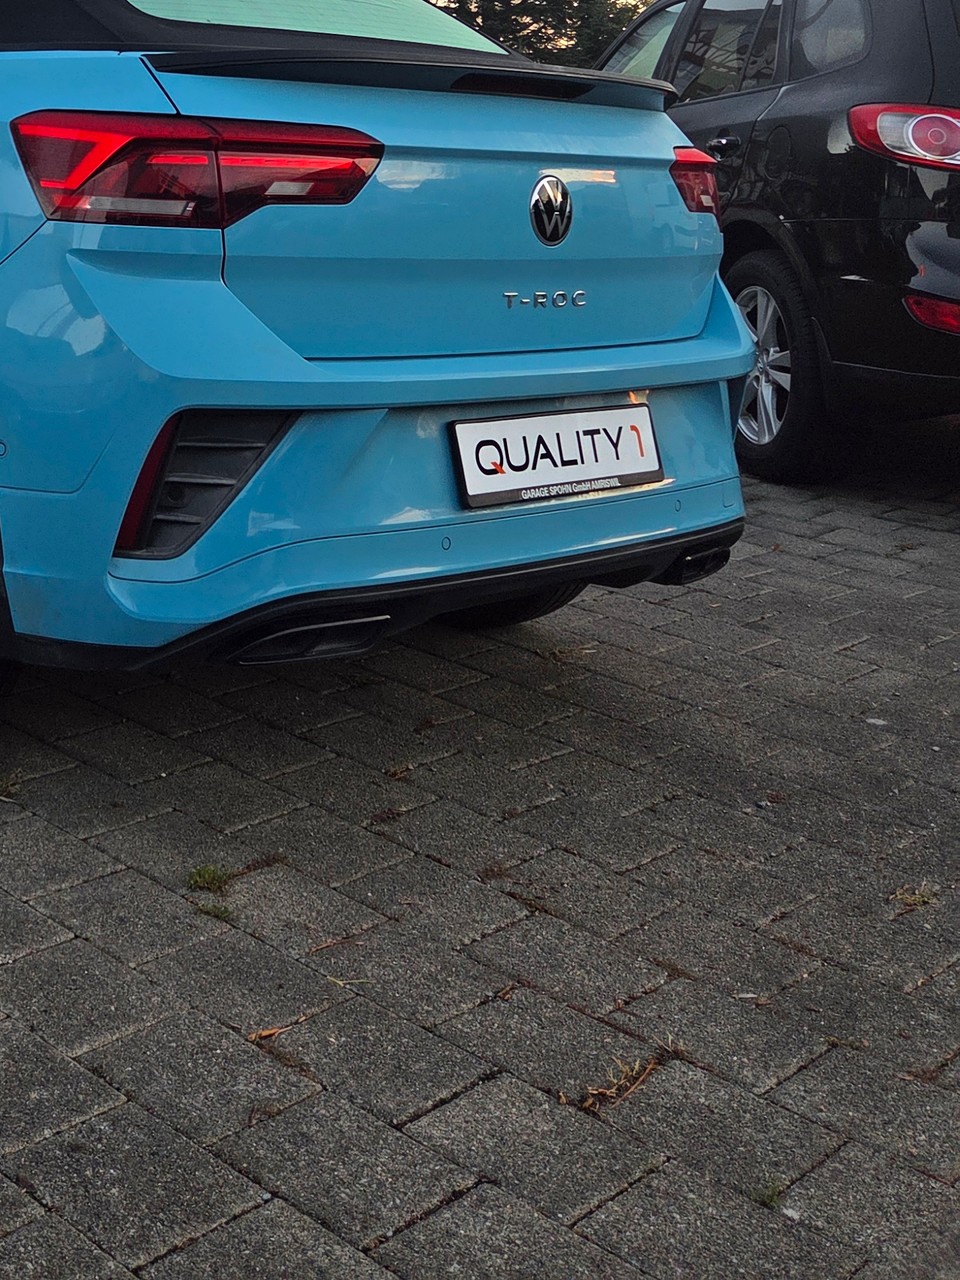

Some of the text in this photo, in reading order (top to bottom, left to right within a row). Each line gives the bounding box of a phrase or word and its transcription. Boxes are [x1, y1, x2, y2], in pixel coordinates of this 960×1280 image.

[503, 290, 587, 308] T-ROC
[521, 477, 621, 500] GARAGE SPOHN GmbH AMRISWIL
